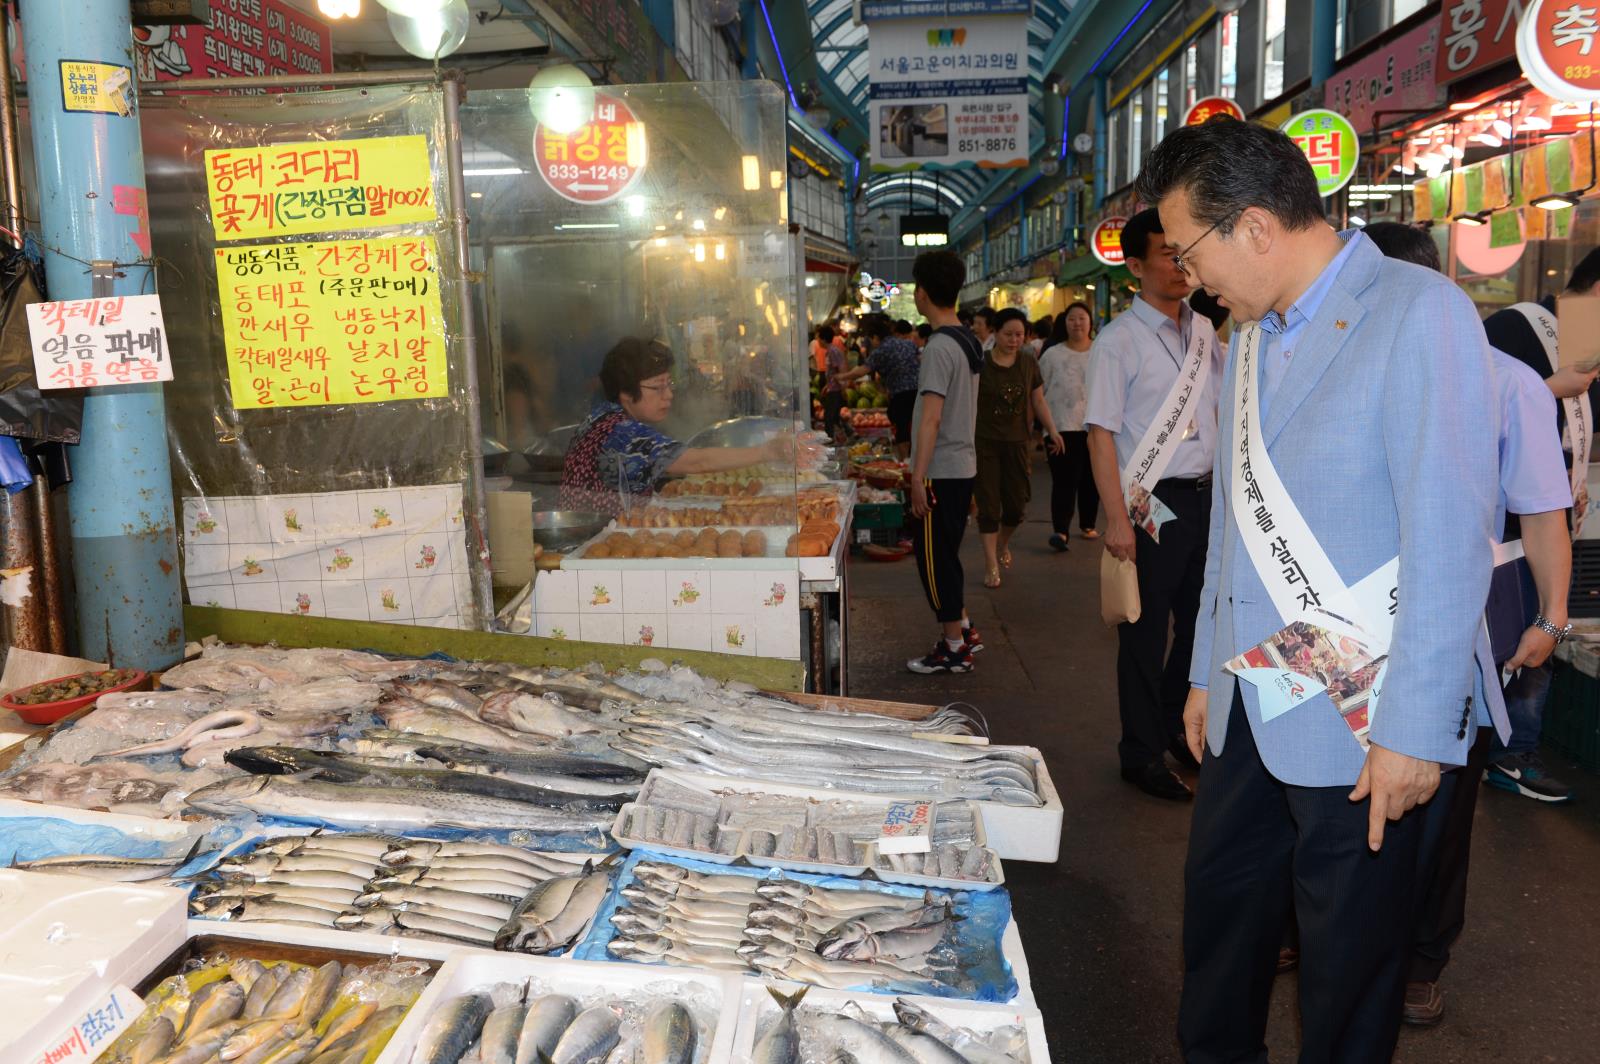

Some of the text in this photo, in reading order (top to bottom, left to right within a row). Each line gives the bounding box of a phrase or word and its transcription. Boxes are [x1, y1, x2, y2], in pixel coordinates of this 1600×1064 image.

[290, 21, 321, 53] 3,000원
[68, 73, 97, 83] 온누리
[880, 53, 1019, 74] 서울고운이치과의원
[69, 82, 98, 95] 상품권
[959, 138, 1016, 152] 851-8876
[549, 165, 630, 181] 833-1249
[234, 281, 310, 313] 동태포
[319, 277, 428, 298] (주문판매)
[39, 297, 125, 334] 칵테일
[239, 313, 313, 342] 깐새우
[335, 305, 426, 335] 냉동낙지
[42, 327, 163, 364] 얼음 판매
[235, 346, 331, 373] 칵테일새우
[49, 362, 100, 388] 식용
[1159, 385, 1192, 447] 지역경제를
[1133, 447, 1161, 484] 살리자
[1239, 412, 1277, 534] 지역경제를
[1269, 535, 1323, 612] 살리자
